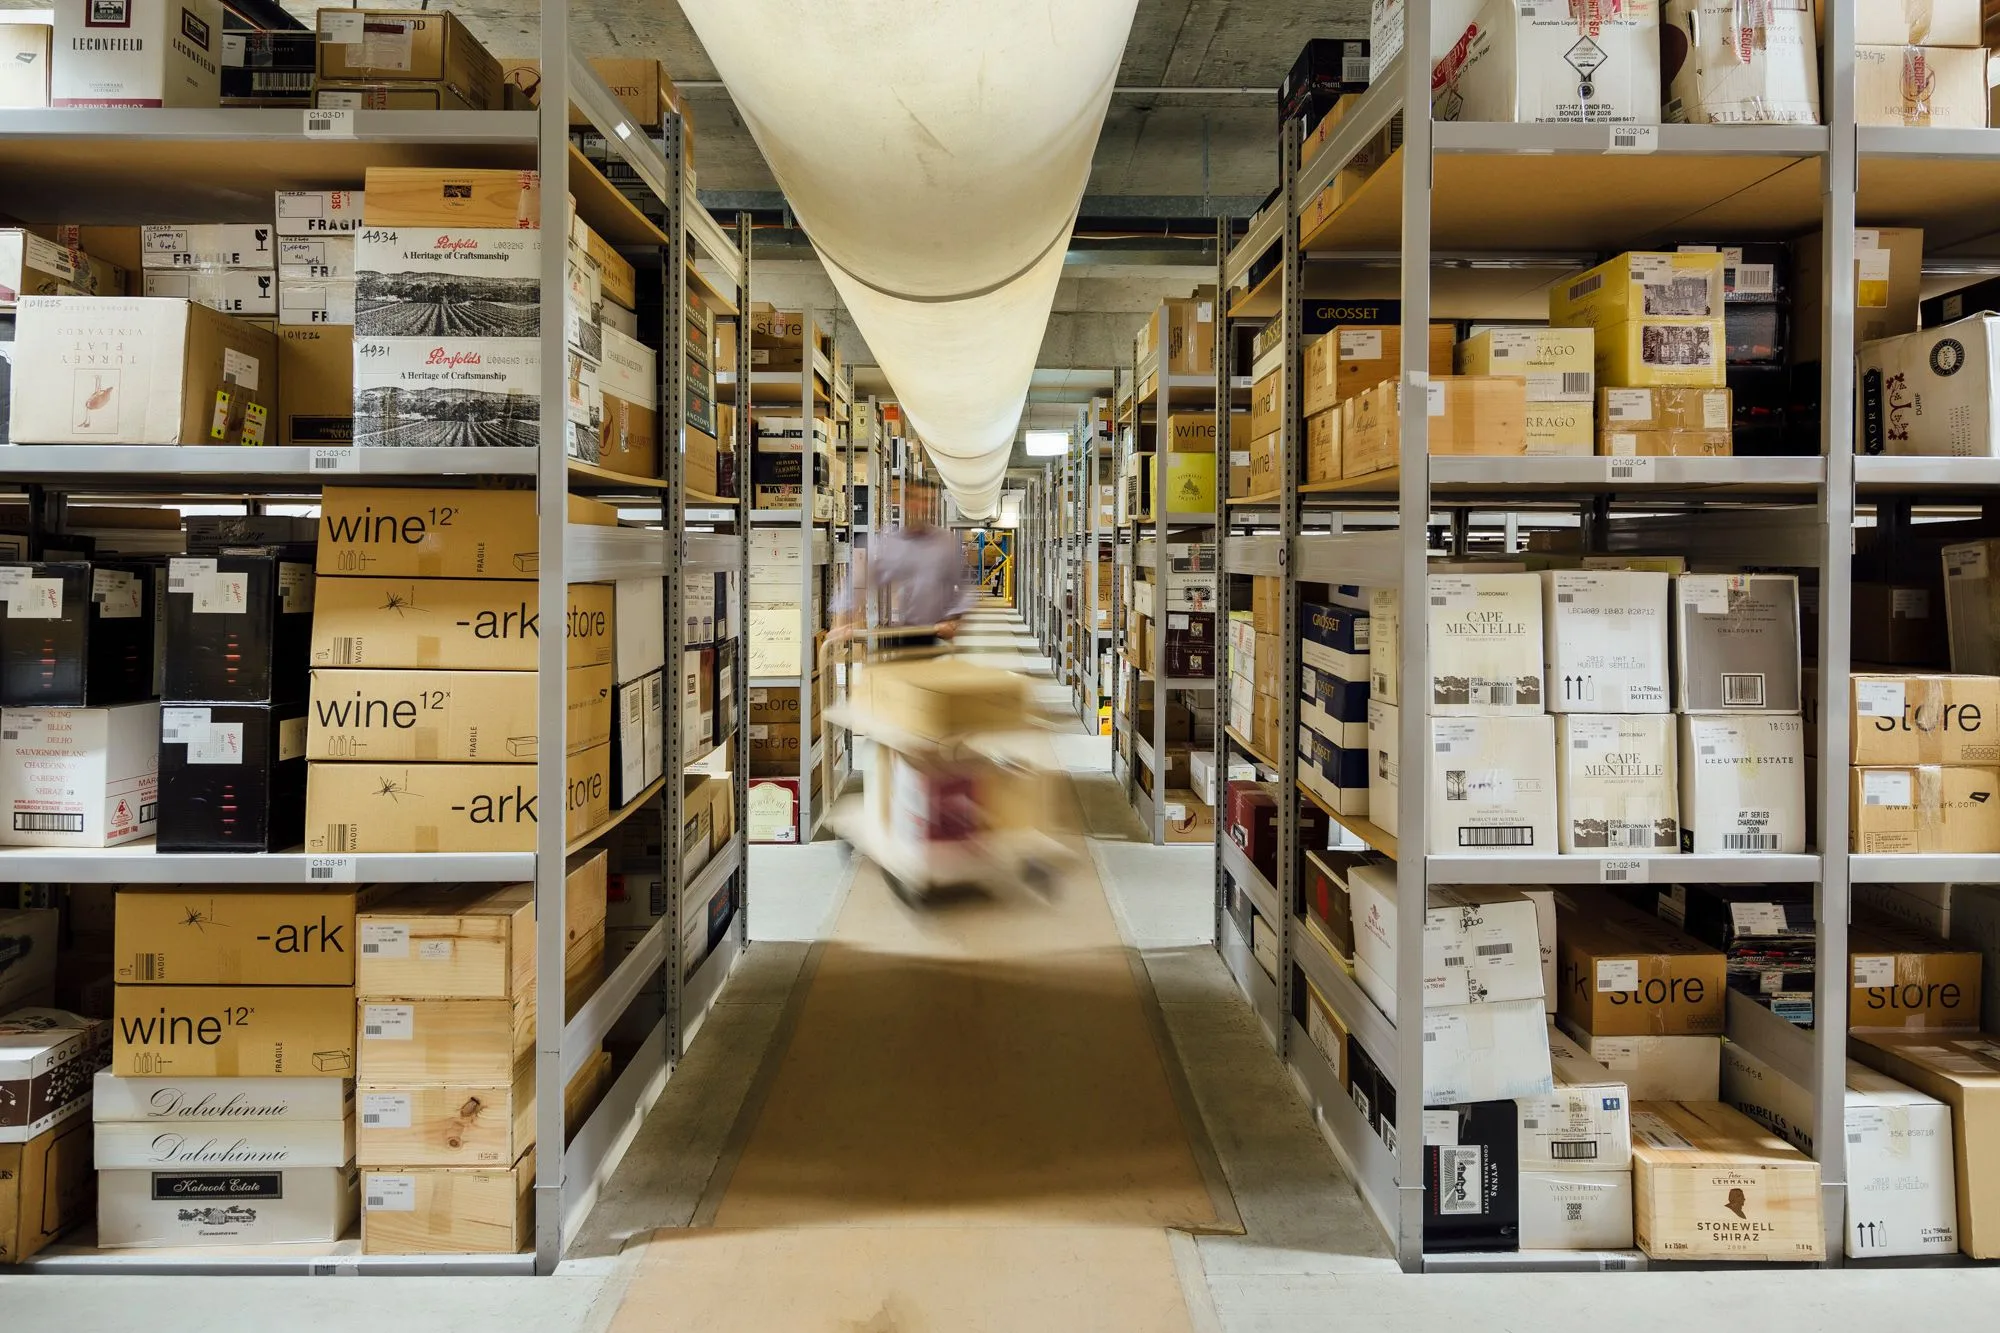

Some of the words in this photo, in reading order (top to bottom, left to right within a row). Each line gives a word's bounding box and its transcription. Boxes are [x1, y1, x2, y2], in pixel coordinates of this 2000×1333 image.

[72, 38, 143, 51] LECONFIELD
[172, 38, 216, 75] LECONFIELD
[1708, 112, 1819, 124] KILLAWARRA
[362, 230, 398, 246] 4934
[433, 234, 478, 252] Penfolds
[410, 251, 442, 261] Heritage
[444, 252, 452, 260] of
[453, 252, 510, 262] Craftsmanship
[1316, 308, 1379, 319] GROSSET
[360, 344, 390, 358] 4931
[425, 347, 481, 368] Penfolds
[408, 372, 440, 381] Heritage
[441, 372, 450, 380] of
[450, 372, 507, 382] Craftsmanship
[1914, 392, 1922, 416] DURIF
[1867, 375, 1878, 450] MORRIS
[1176, 422, 1216, 438] wine
[1526, 417, 1576, 428] RRAGO
[1612, 458, 1647, 466] C1-02-C4
[327, 507, 426, 545] wine
[476, 542, 485, 573] FRAGILE
[1312, 613, 1340, 632] GROSSET
[1466, 610, 1504, 622] CAPE
[1446, 623, 1526, 634] MENTELLE
[316, 690, 417, 729] wine
[469, 724, 478, 758] FRAGILE
[16, 748, 61, 757] SAUVIGNON
[1605, 752, 1641, 764] CAPE
[1584, 764, 1664, 776] MENTELLE
[566, 770, 602, 811] tore
[1606, 861, 1640, 869] C1-02-B4
[256, 916, 344, 954] -ark
[120, 1007, 222, 1046] wine
[274, 1041, 283, 1073] FRAGILE
[147, 1088, 288, 1118] Dalwhinnie
[148, 1132, 290, 1163] Dalwhinnie
[173, 1180, 226, 1192] Katnook
[229, 1178, 260, 1192] Estate
[1490, 1162, 1499, 1198] WYNNS
[1696, 1222, 1775, 1232] STONEWELL
[1713, 1233, 1760, 1242] SHIRAZ
